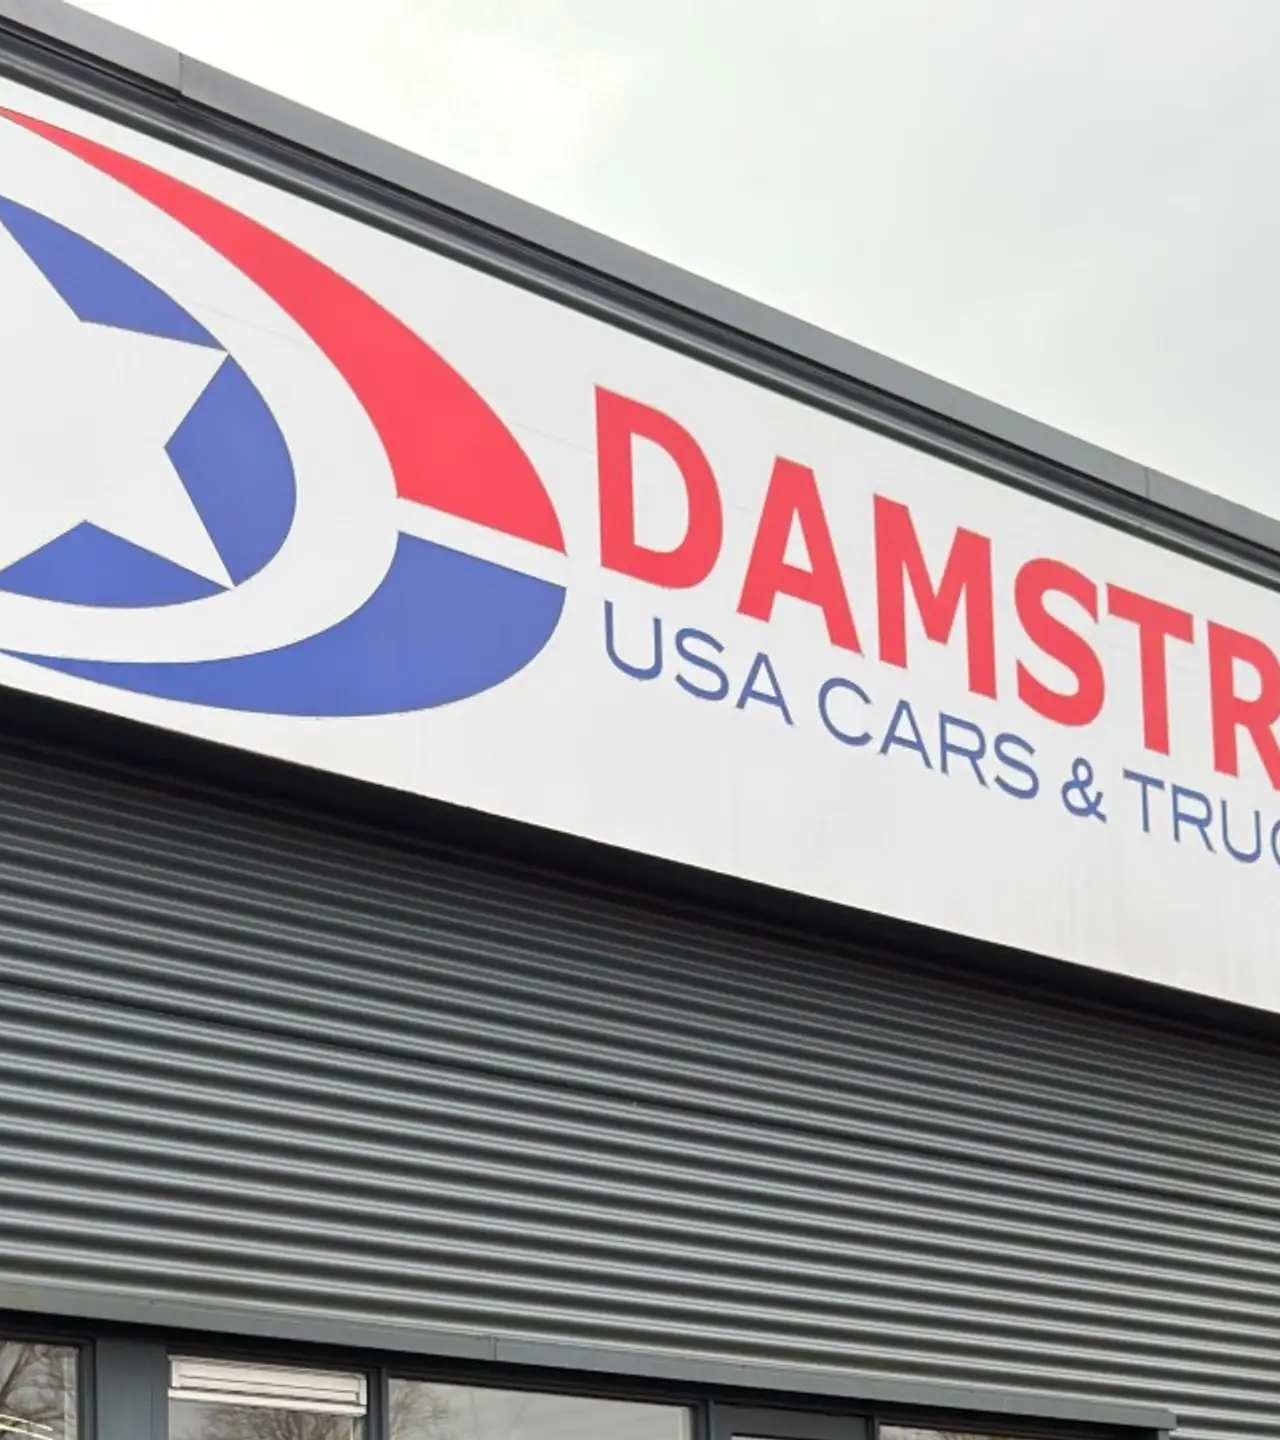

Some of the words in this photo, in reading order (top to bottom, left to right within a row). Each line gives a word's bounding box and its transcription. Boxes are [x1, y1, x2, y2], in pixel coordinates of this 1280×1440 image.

[603, 601, 793, 725] USA
[818, 677, 1040, 799] CARS
[1061, 758, 1107, 823] &
